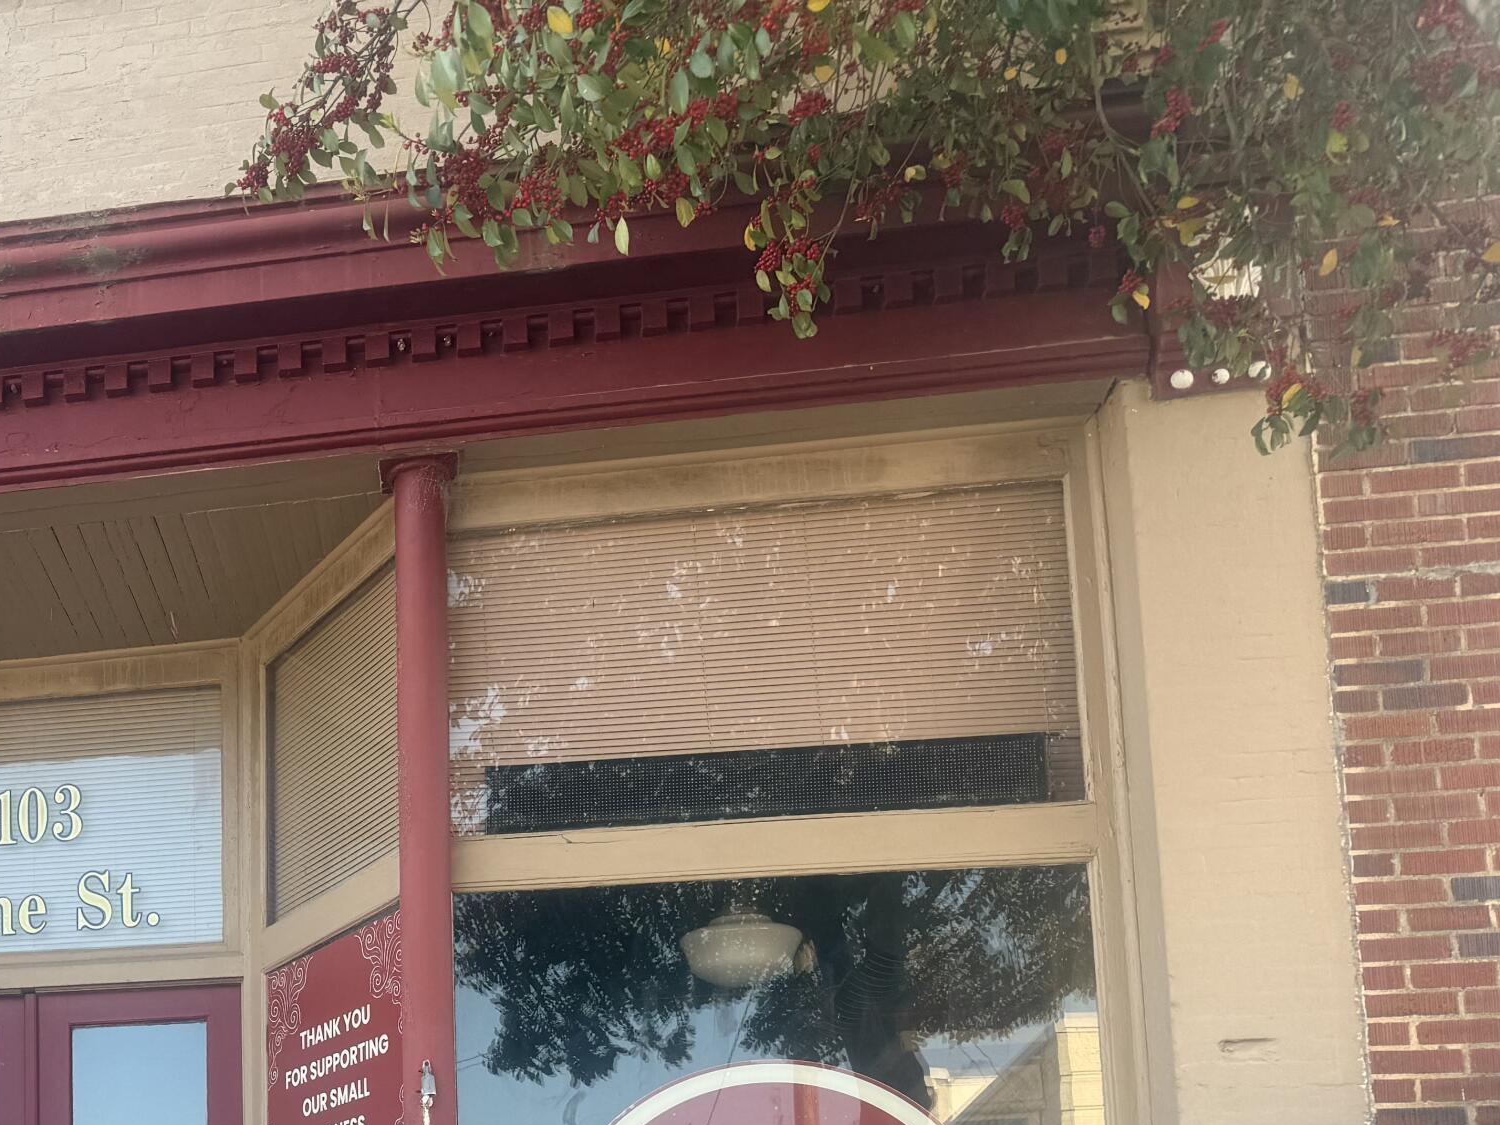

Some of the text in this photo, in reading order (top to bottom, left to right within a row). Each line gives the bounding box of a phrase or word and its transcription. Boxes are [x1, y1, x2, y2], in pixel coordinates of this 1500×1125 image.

[76, 869, 161, 932] St.
[299, 1003, 371, 1050] THANK YOU
[285, 1033, 389, 1090] FOR SUPPORTING
[302, 1077, 371, 1117] OUR SMALL
